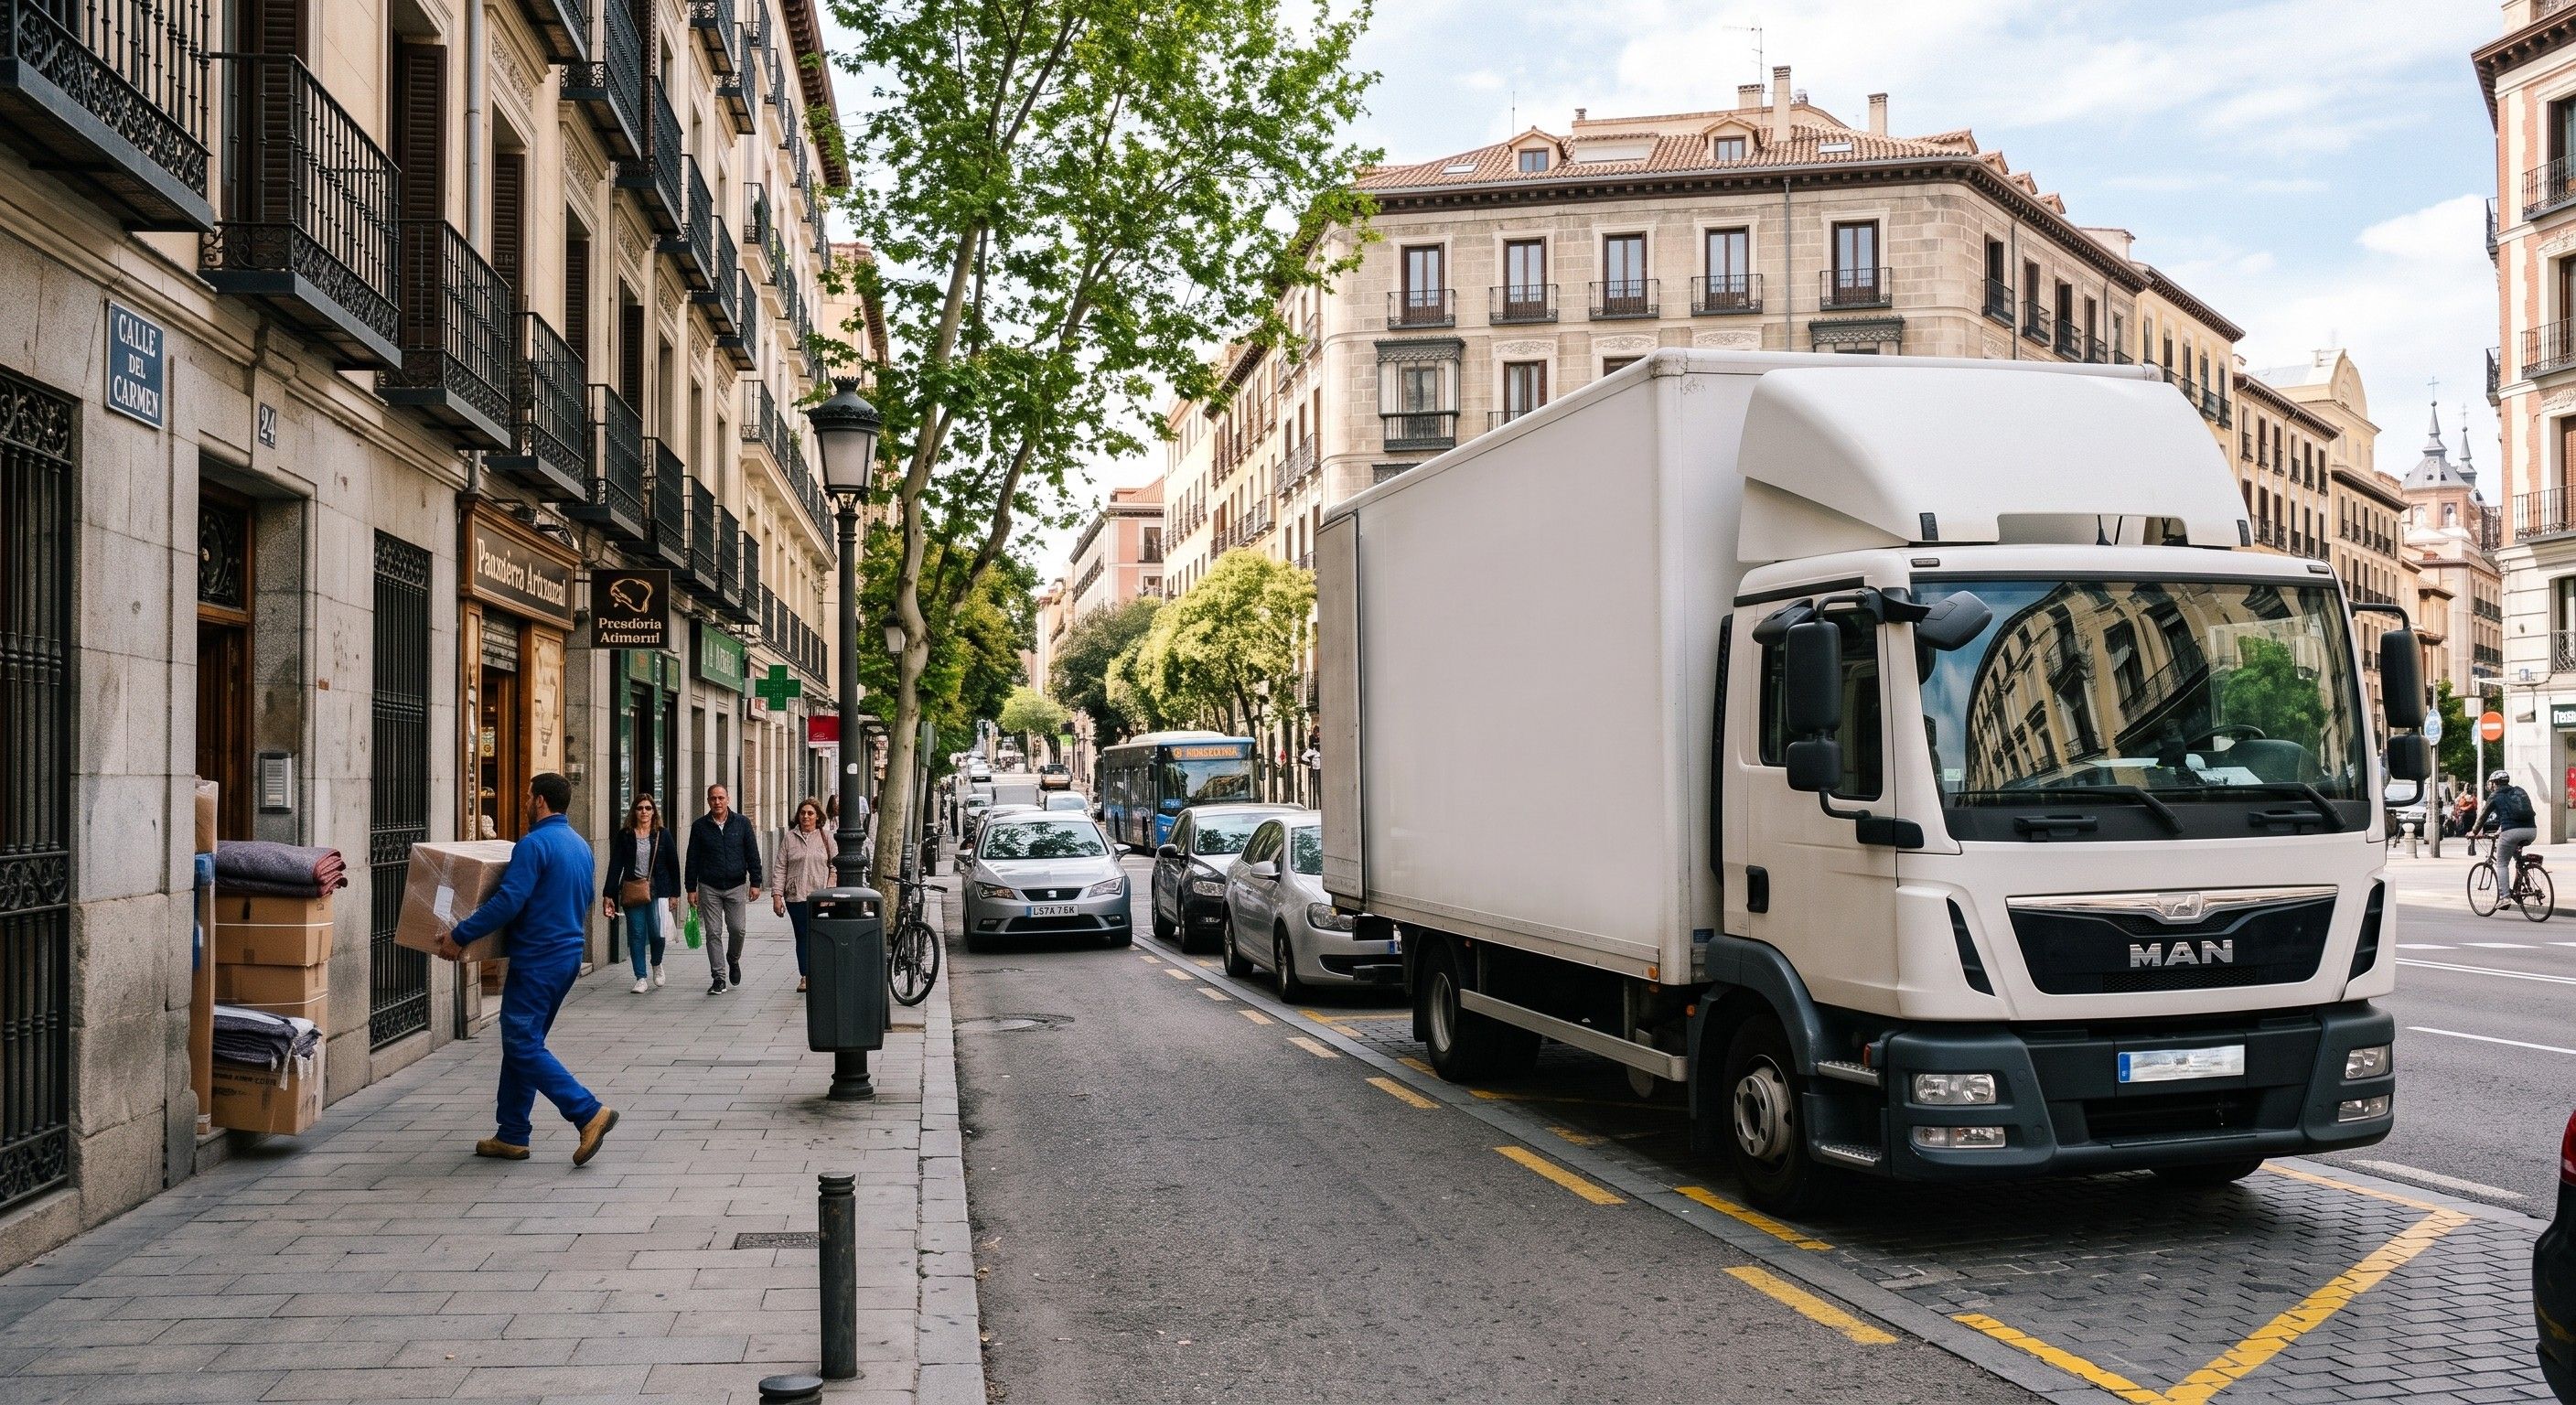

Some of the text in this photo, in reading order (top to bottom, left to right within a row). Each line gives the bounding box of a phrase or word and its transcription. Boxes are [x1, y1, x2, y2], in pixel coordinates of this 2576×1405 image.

[118, 313, 156, 358] CALLE
[128, 352, 146, 380] DEL
[113, 375, 159, 419] CARMEN
[260, 406, 275, 444] 24
[2129, 939, 2234, 968] MAN
